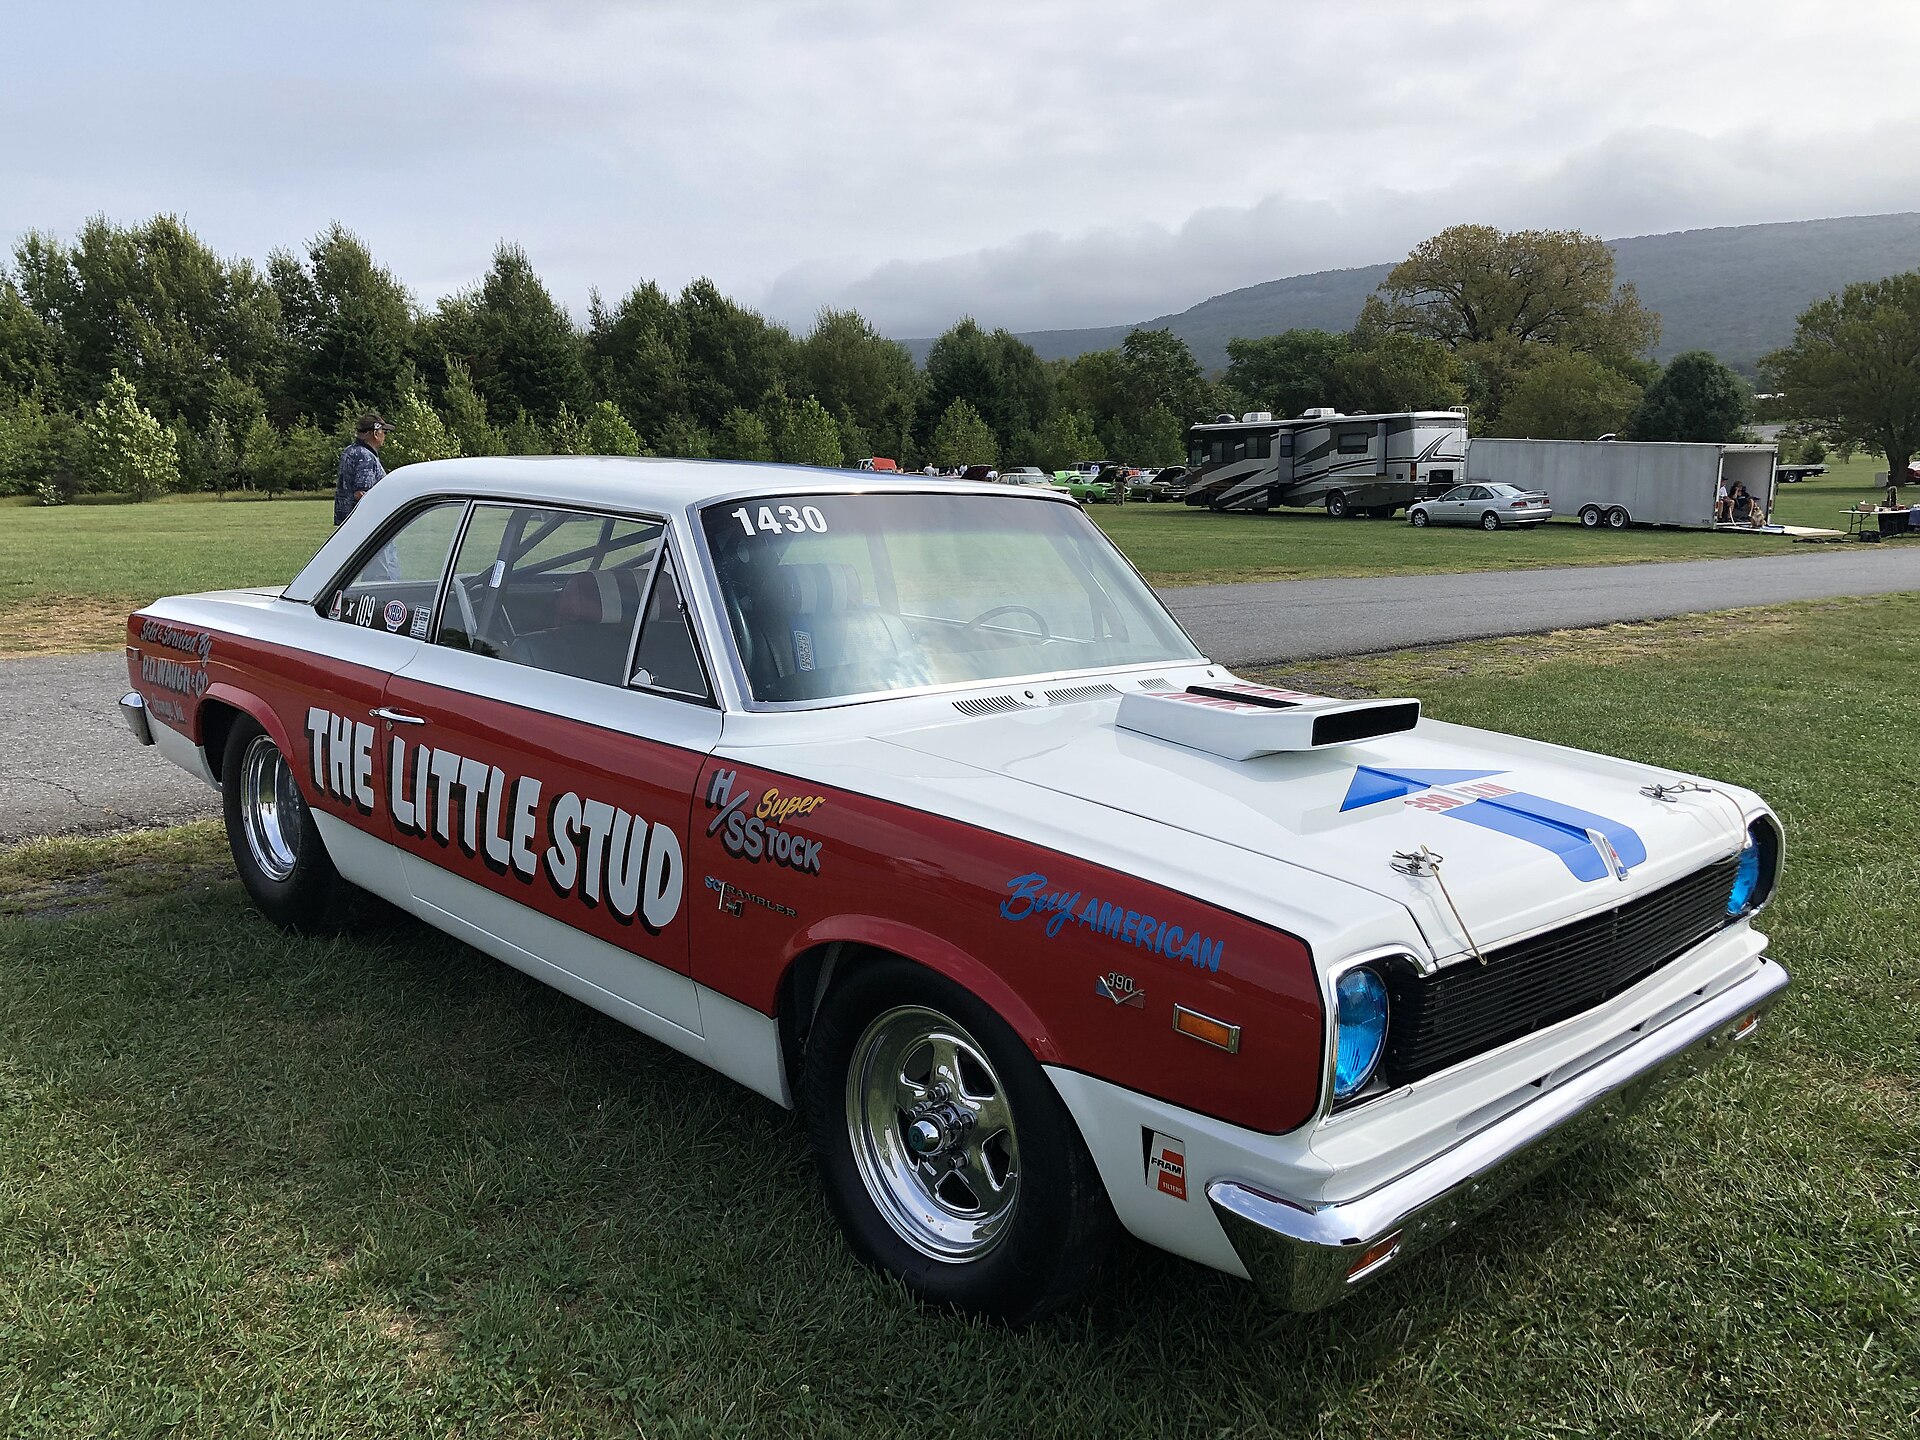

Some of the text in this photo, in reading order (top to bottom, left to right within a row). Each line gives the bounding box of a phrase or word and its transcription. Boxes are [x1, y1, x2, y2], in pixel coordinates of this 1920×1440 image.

[731, 505, 828, 537] 1430
[355, 594, 376, 628] 109
[305, 706, 684, 932] THE LITTLE STUD
[756, 788, 827, 824] Super
[1000, 872, 1224, 973] Buy AMERICAN
[1106, 972, 1134, 993] 390
[1150, 1156, 1182, 1175] FRAM
[1162, 1181, 1183, 1195] FILTERS
